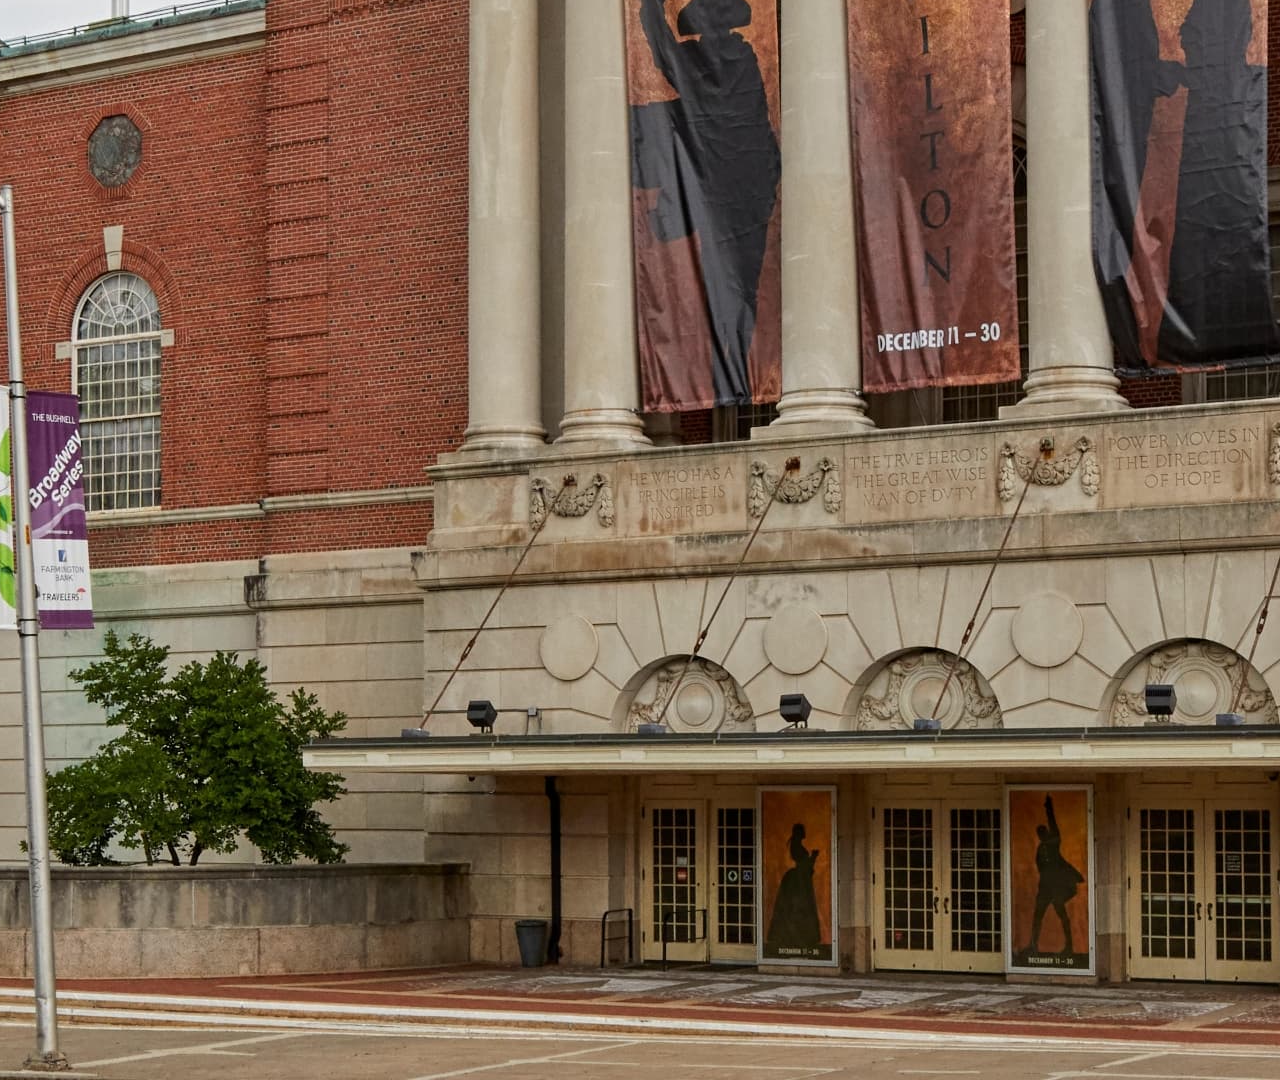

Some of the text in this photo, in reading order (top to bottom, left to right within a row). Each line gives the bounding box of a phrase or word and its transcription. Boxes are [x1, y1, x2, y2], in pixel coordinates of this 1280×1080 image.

[877, 327, 944, 353] DECEMBER
[947, 326, 959, 345] 11
[980, 322, 1001, 341] 30
[32, 413, 75, 425] THE BUSHNELL
[1108, 427, 1259, 451] POWER MOVES IN
[850, 455, 880, 469] THE
[928, 448, 972, 465] HERO
[975, 447, 988, 461] IS
[1115, 448, 1252, 470] THE DIRECTION
[29, 428, 82, 510] Broadway
[630, 466, 734, 486] HE WHO HAS A
[853, 467, 987, 488] THE GREAT WISE
[1144, 470, 1222, 488] OF HOPE
[51, 459, 84, 508] Series
[640, 485, 726, 502] PRINCIPLE IS
[864, 491, 900, 506] MAN
[905, 490, 927, 504] OF
[650, 504, 714, 520] INSPIRED
[41, 565, 84, 574] FARMINGTON
[42, 592, 80, 602] TRAVELERS
